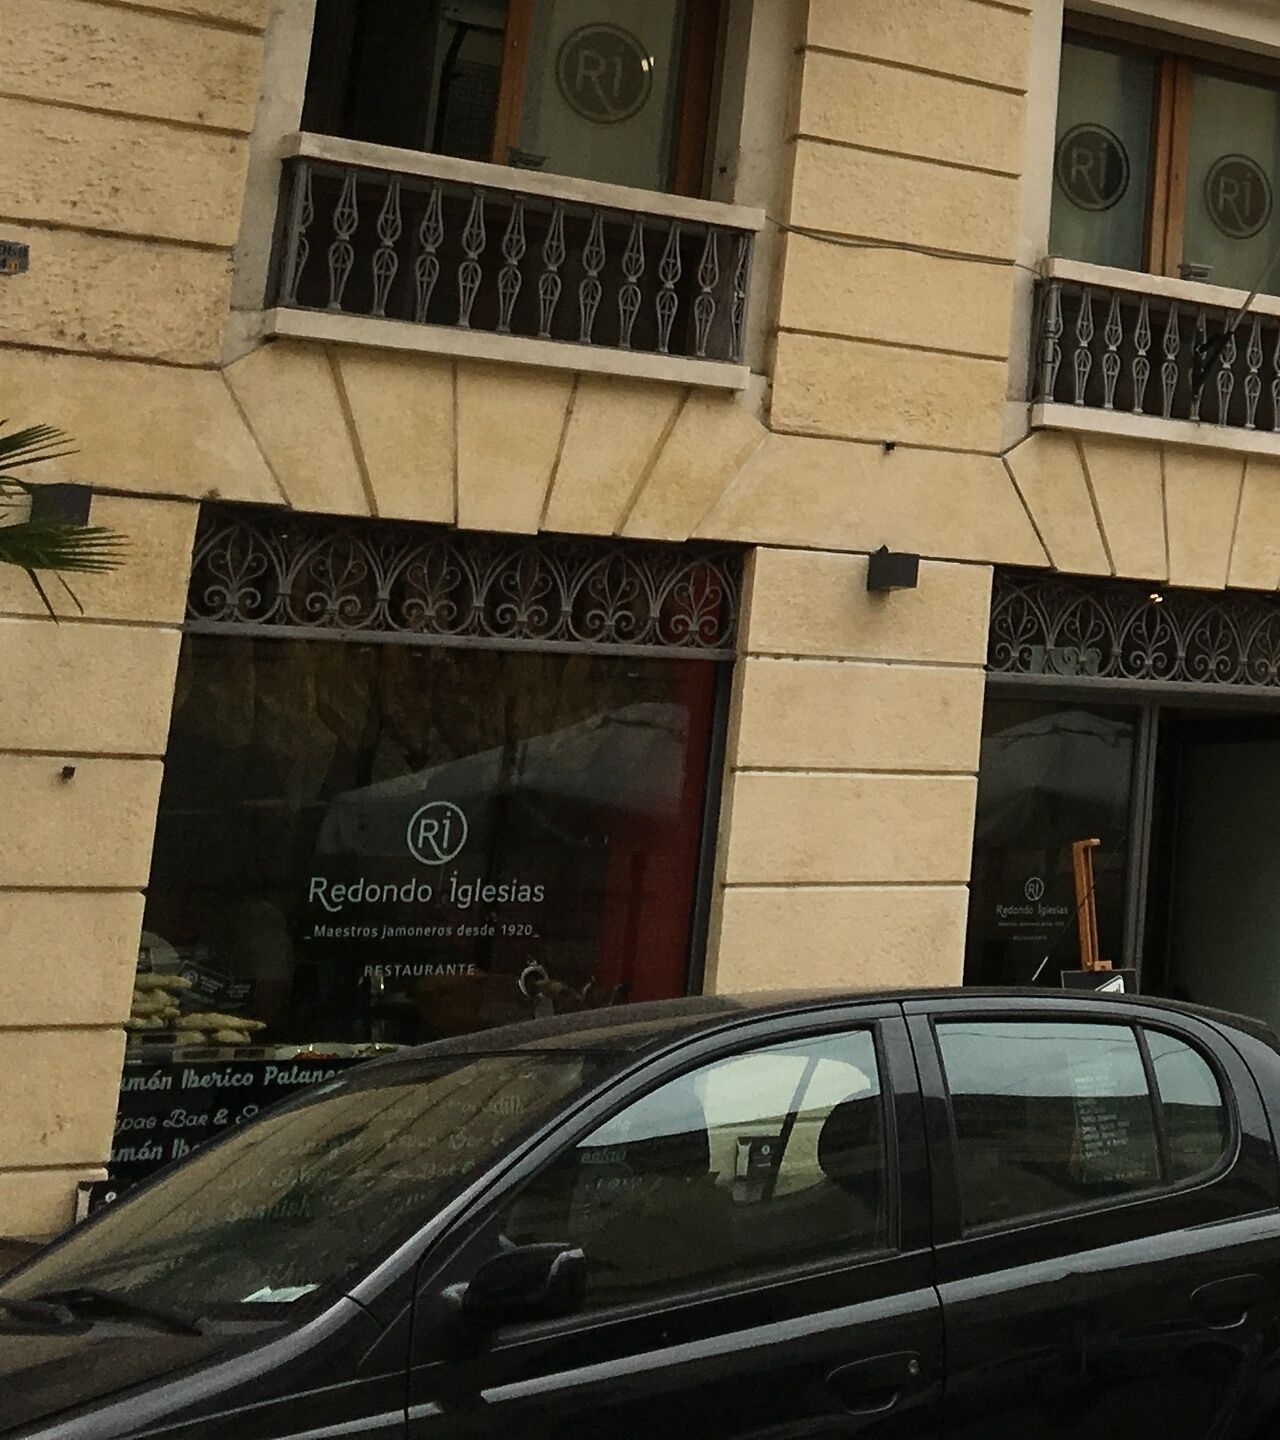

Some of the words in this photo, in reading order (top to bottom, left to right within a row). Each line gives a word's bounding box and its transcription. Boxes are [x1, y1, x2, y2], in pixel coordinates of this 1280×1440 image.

[308, 876, 433, 912] Redondo
[996, 904, 1034, 918] Redondo
[381, 925, 452, 939] jamoneros
[457, 923, 495, 937] desde
[364, 963, 476, 977] RESTAURANTE
[181, 1067, 254, 1089] Iberico
[213, 1108, 228, 1125] &
